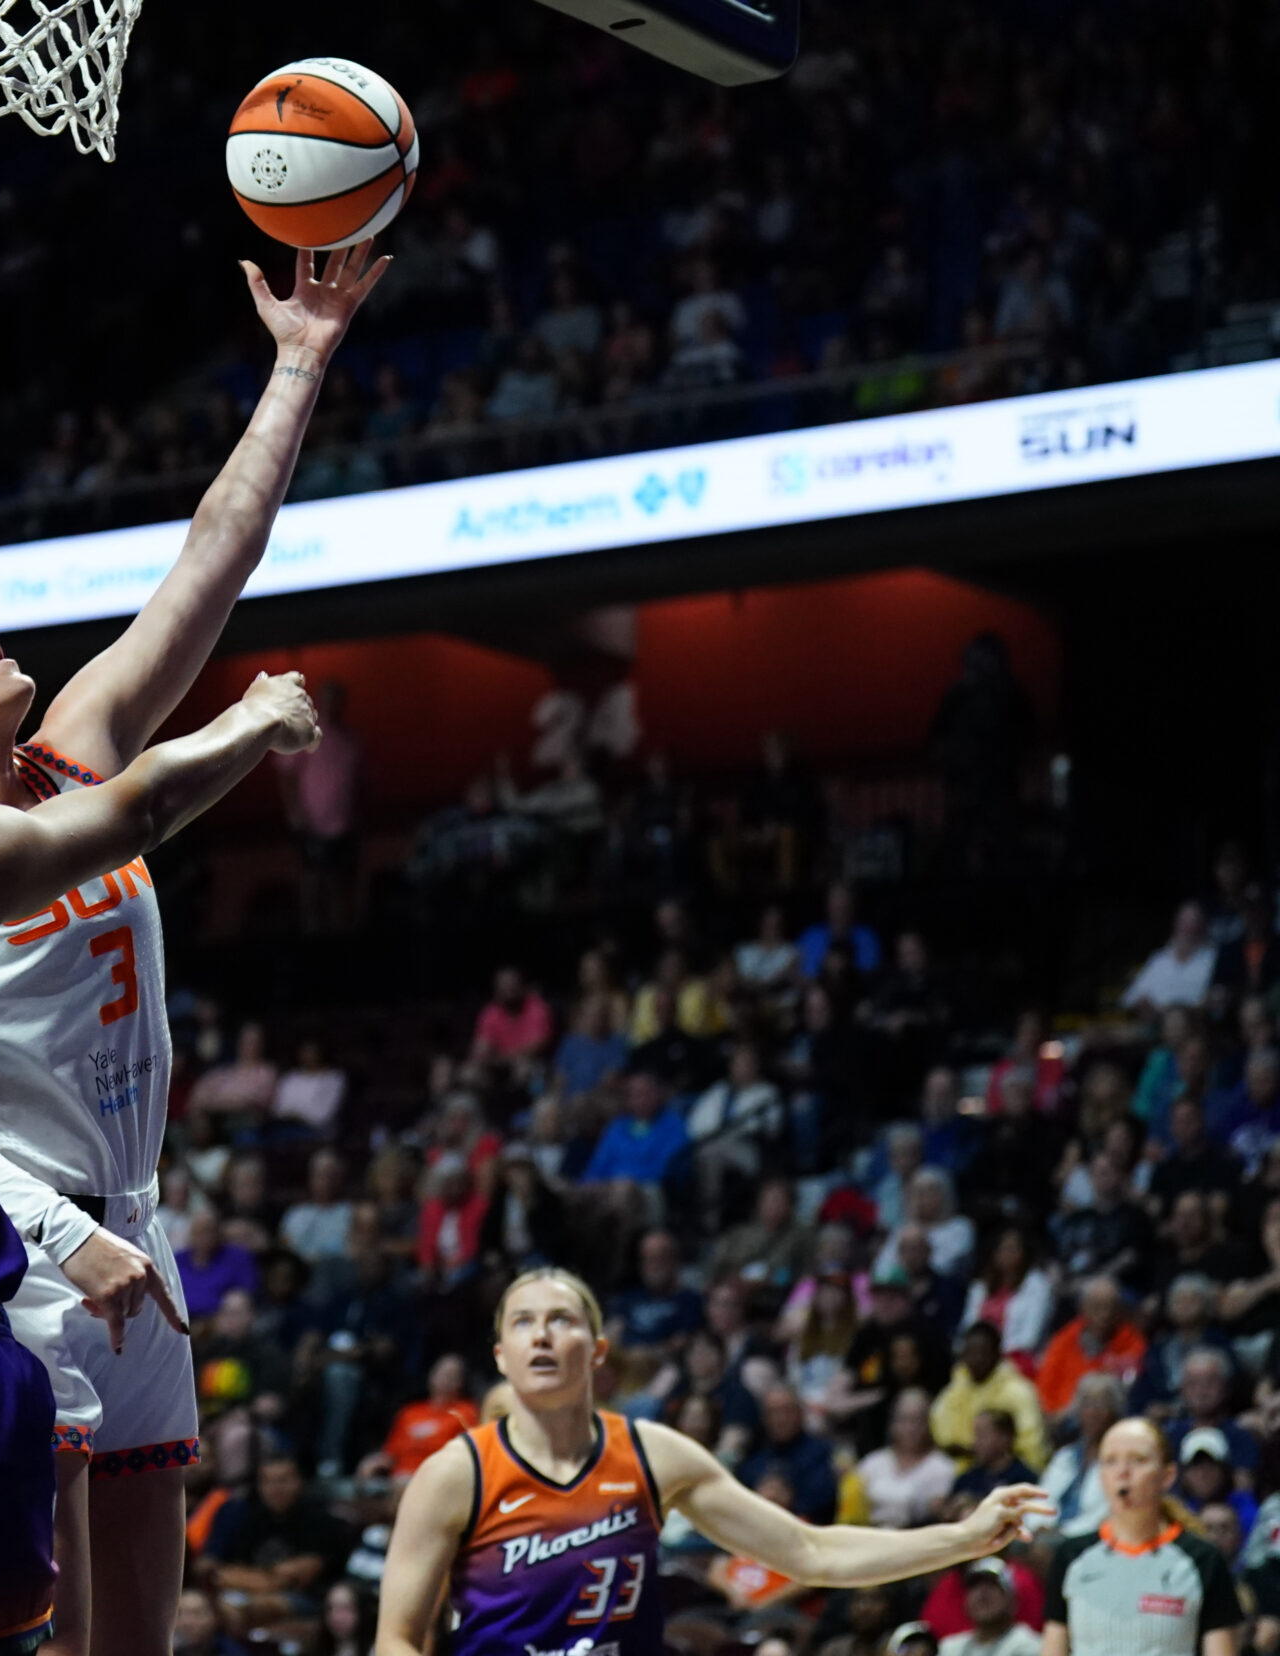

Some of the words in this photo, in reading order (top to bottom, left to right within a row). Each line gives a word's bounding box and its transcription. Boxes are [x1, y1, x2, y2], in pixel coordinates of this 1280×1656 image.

[1020, 420, 1136, 462] SUN
[448, 493, 622, 545] Anthem
[89, 926, 139, 1026] 3
[88, 1047, 117, 1071] Yale
[501, 1504, 638, 1574] Phoenix
[568, 1554, 645, 1625] 33
